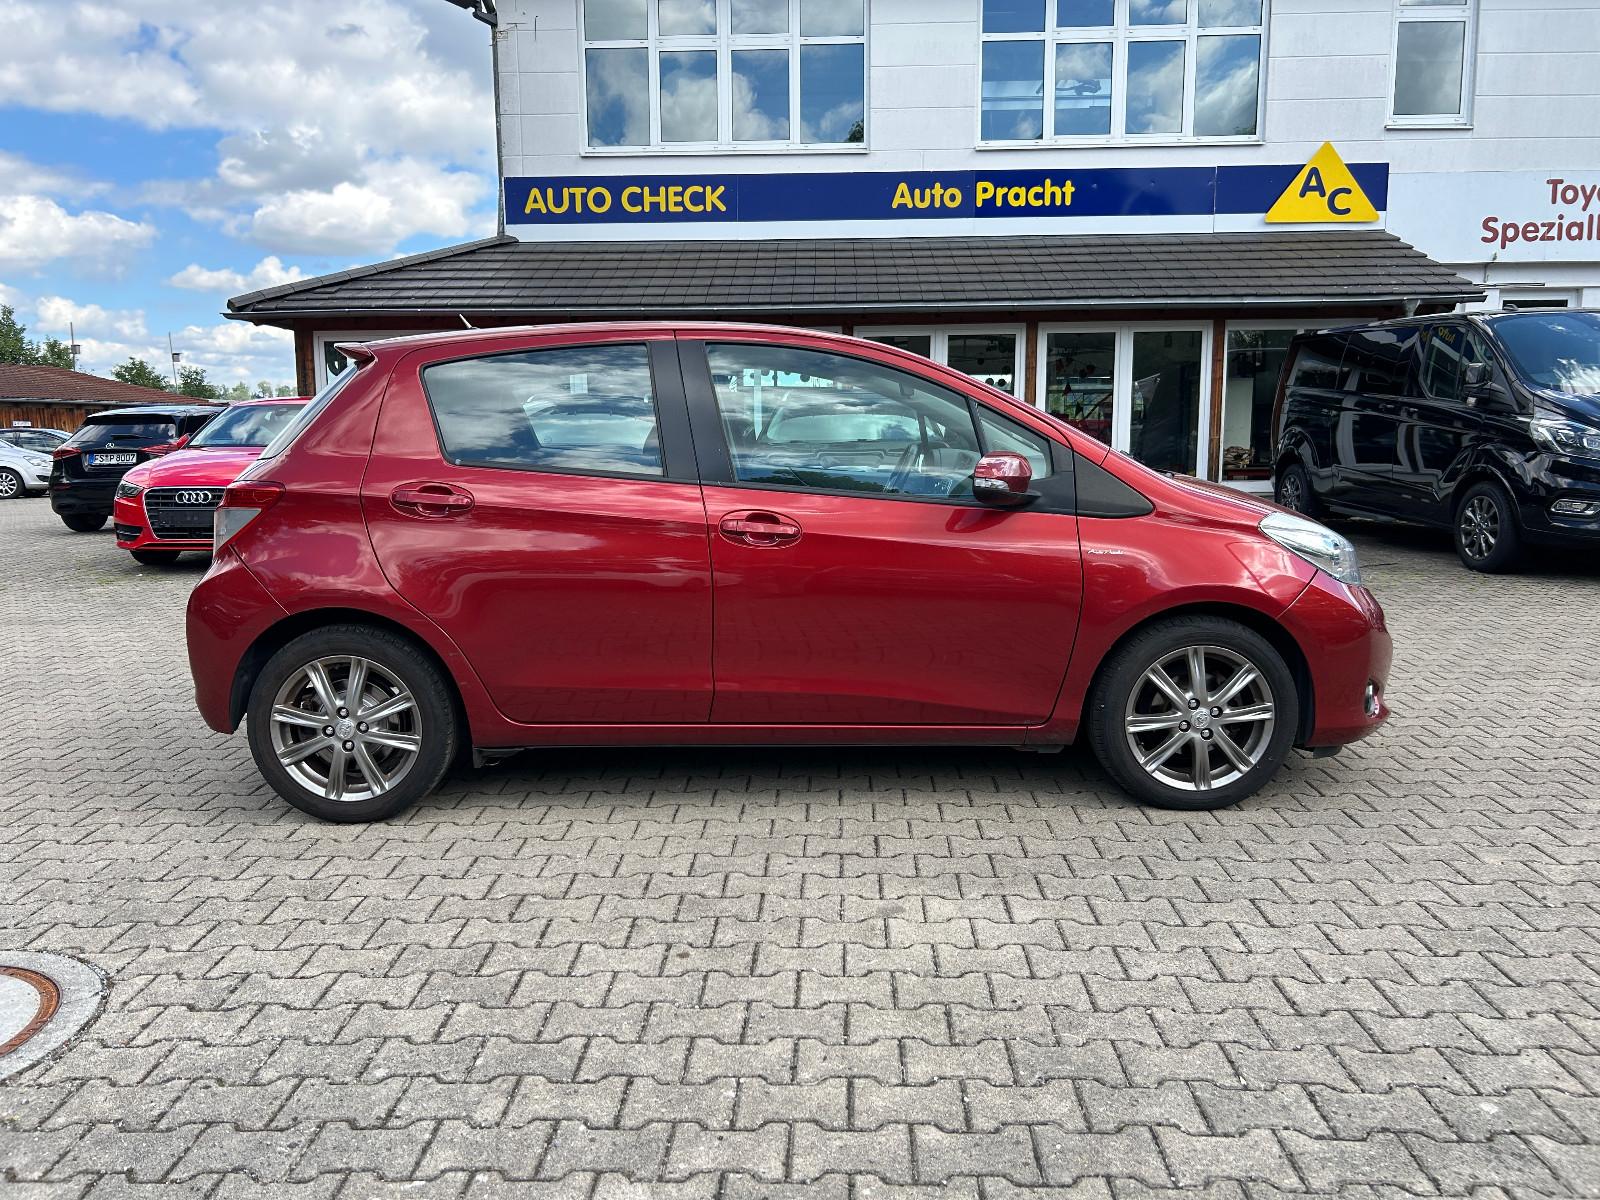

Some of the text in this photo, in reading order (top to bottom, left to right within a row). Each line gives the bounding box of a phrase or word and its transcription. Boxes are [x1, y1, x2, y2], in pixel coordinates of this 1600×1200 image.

[524, 185, 727, 215] AUTO CHECK
[891, 178, 1076, 209] Auto Pracht
[1481, 213, 1600, 249] Spezial
